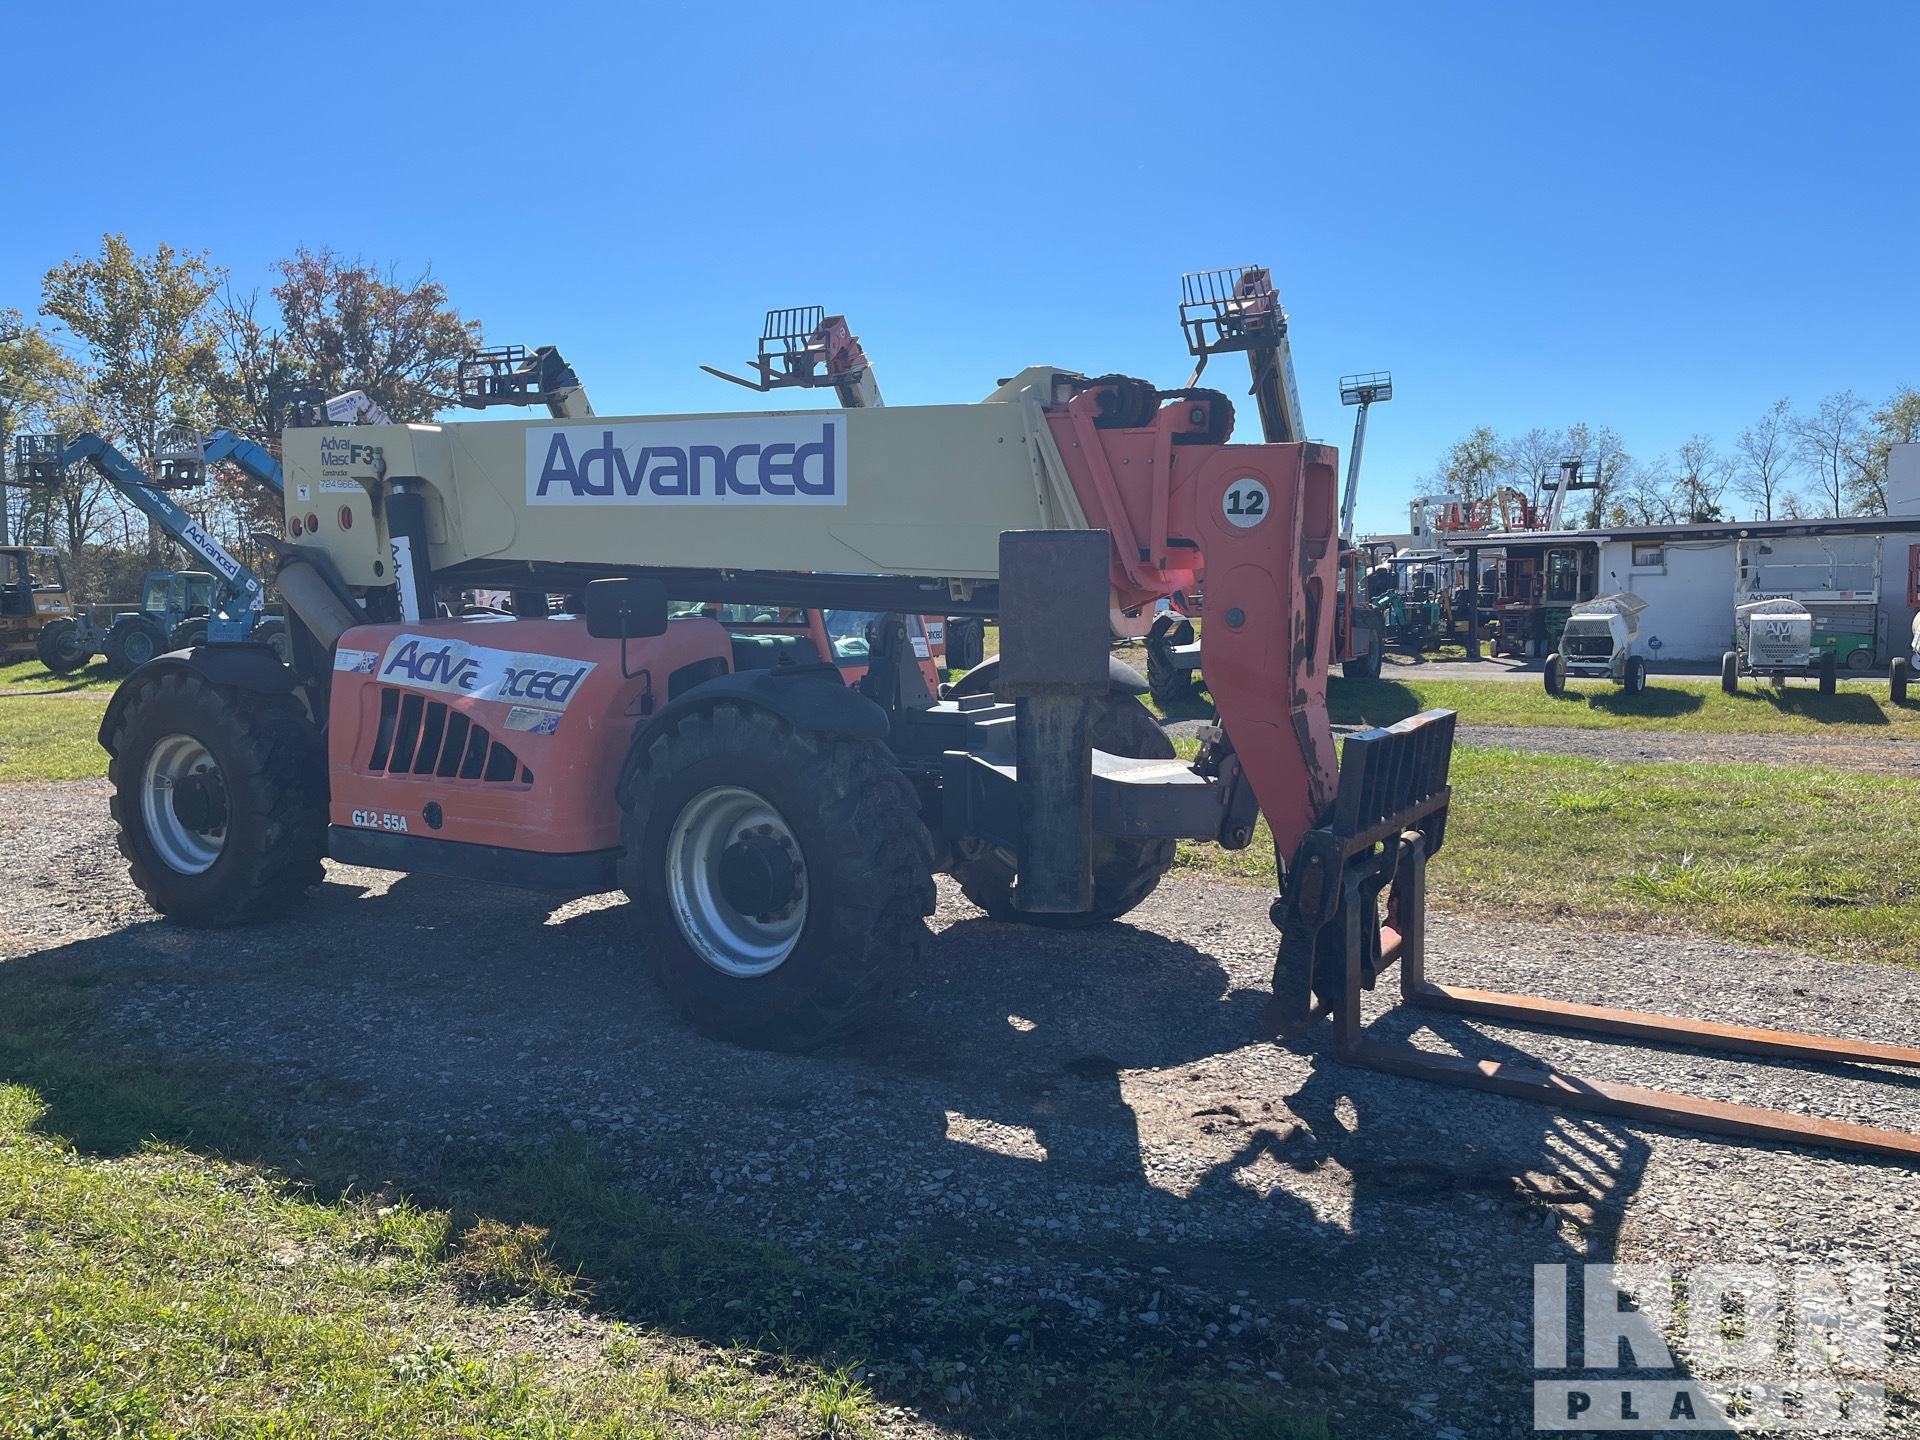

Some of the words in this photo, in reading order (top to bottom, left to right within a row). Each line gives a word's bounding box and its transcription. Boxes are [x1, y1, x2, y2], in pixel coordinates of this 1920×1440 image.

[350, 445, 382, 465] F3
[536, 423, 835, 497] Advanced
[1227, 490, 1264, 515] 12
[185, 526, 238, 576] Advanced
[352, 809, 408, 832] G12-55A
